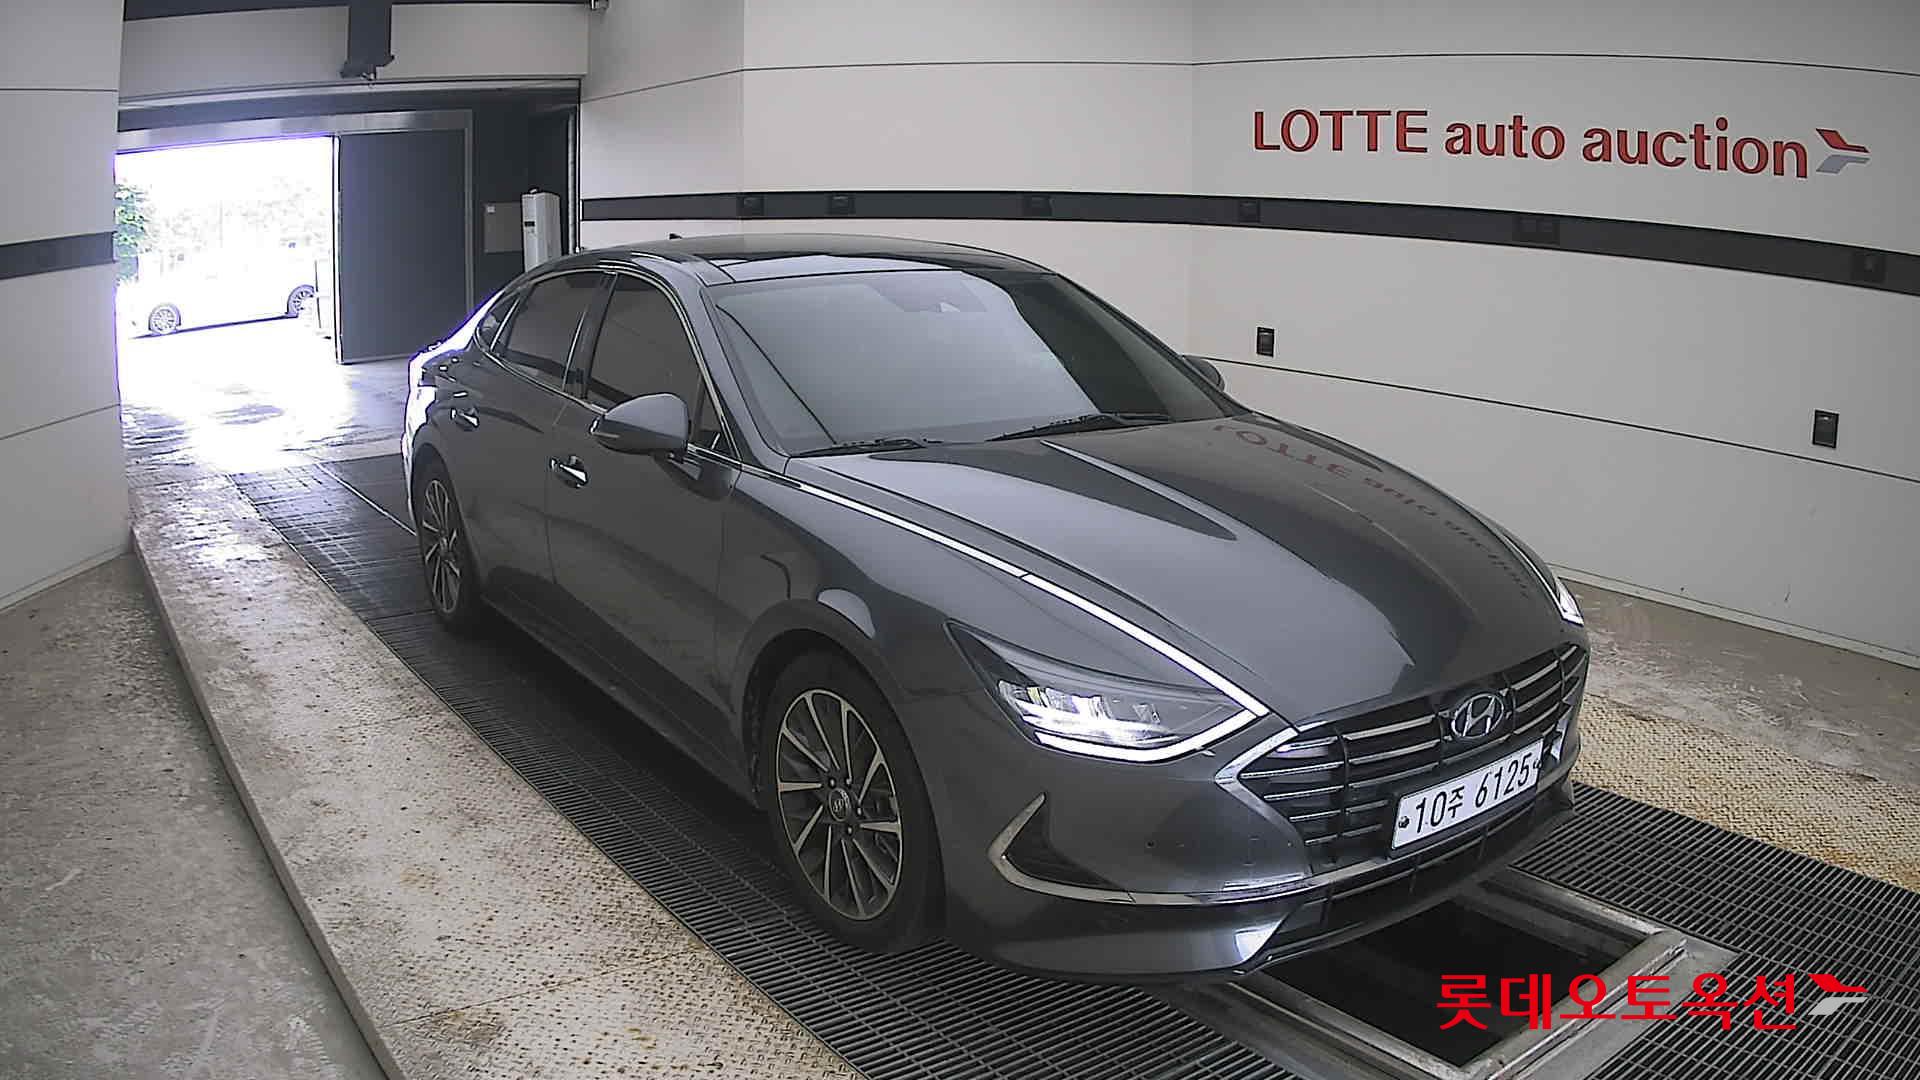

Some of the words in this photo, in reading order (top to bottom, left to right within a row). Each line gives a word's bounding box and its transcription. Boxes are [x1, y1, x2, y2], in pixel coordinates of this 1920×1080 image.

[1253, 109, 1429, 153] LOTTE
[1444, 115, 1566, 160] auto
[1582, 117, 1808, 178] auction
[1415, 786, 1466, 833] 10주
[1475, 752, 1532, 808] 6125
